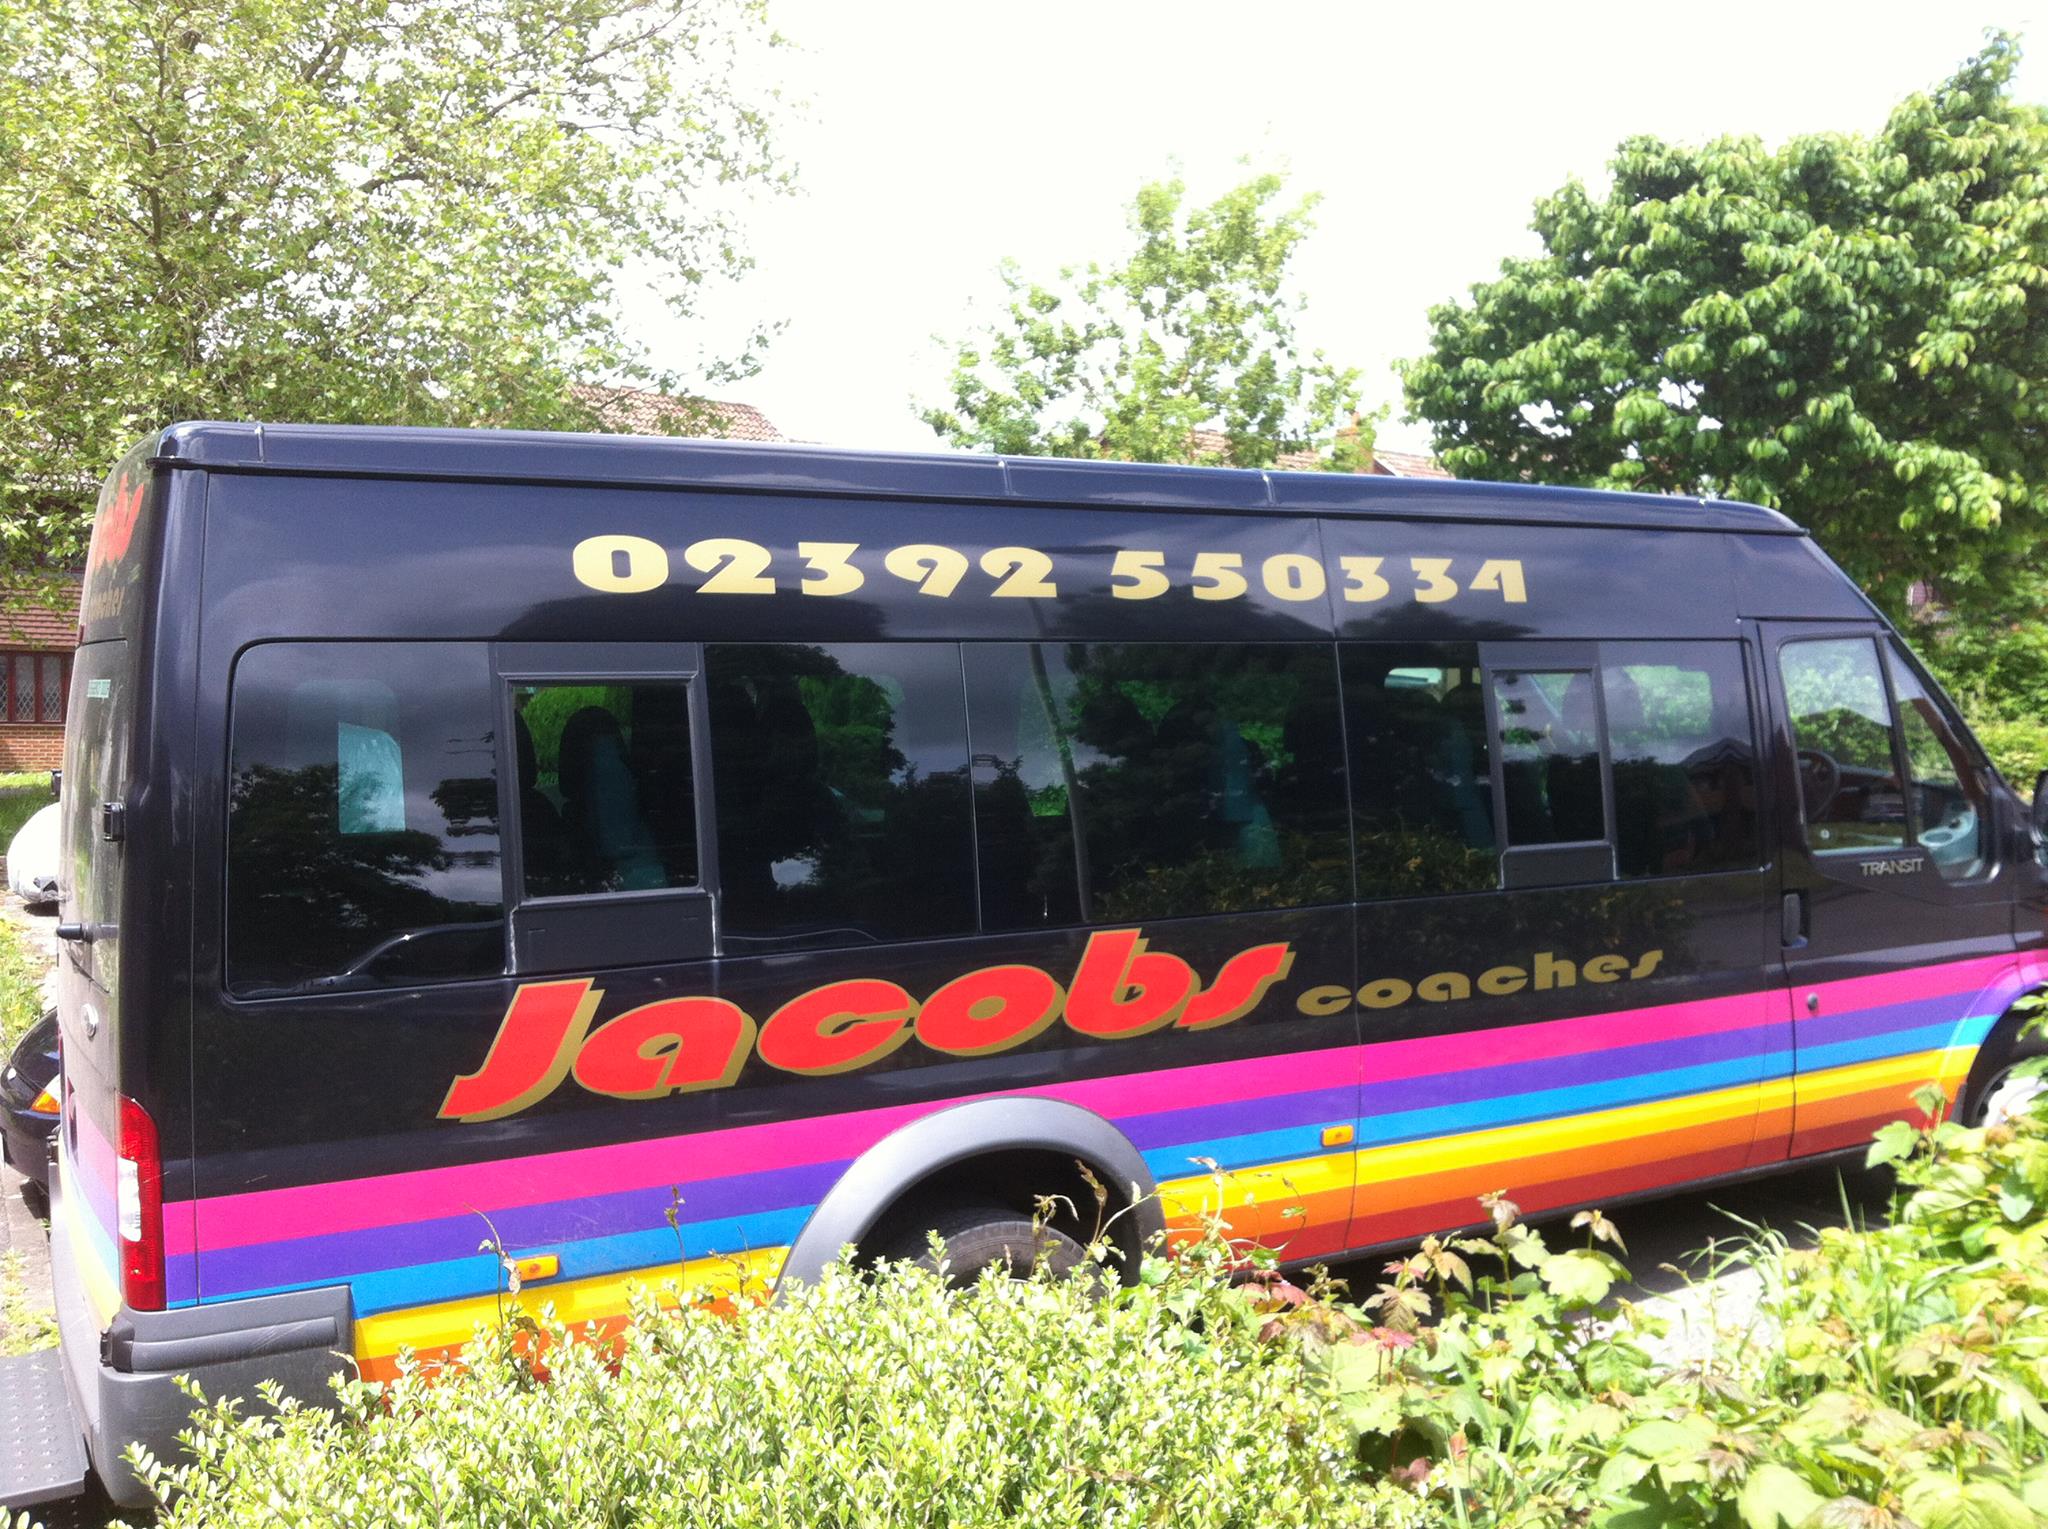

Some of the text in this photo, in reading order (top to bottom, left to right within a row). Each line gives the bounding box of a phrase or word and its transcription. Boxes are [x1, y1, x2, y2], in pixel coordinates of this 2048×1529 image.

[573, 534, 1527, 604] 02392 550334
[1860, 857, 1925, 877] TRANSIT
[436, 927, 1664, 1123] Jacobs coaches
